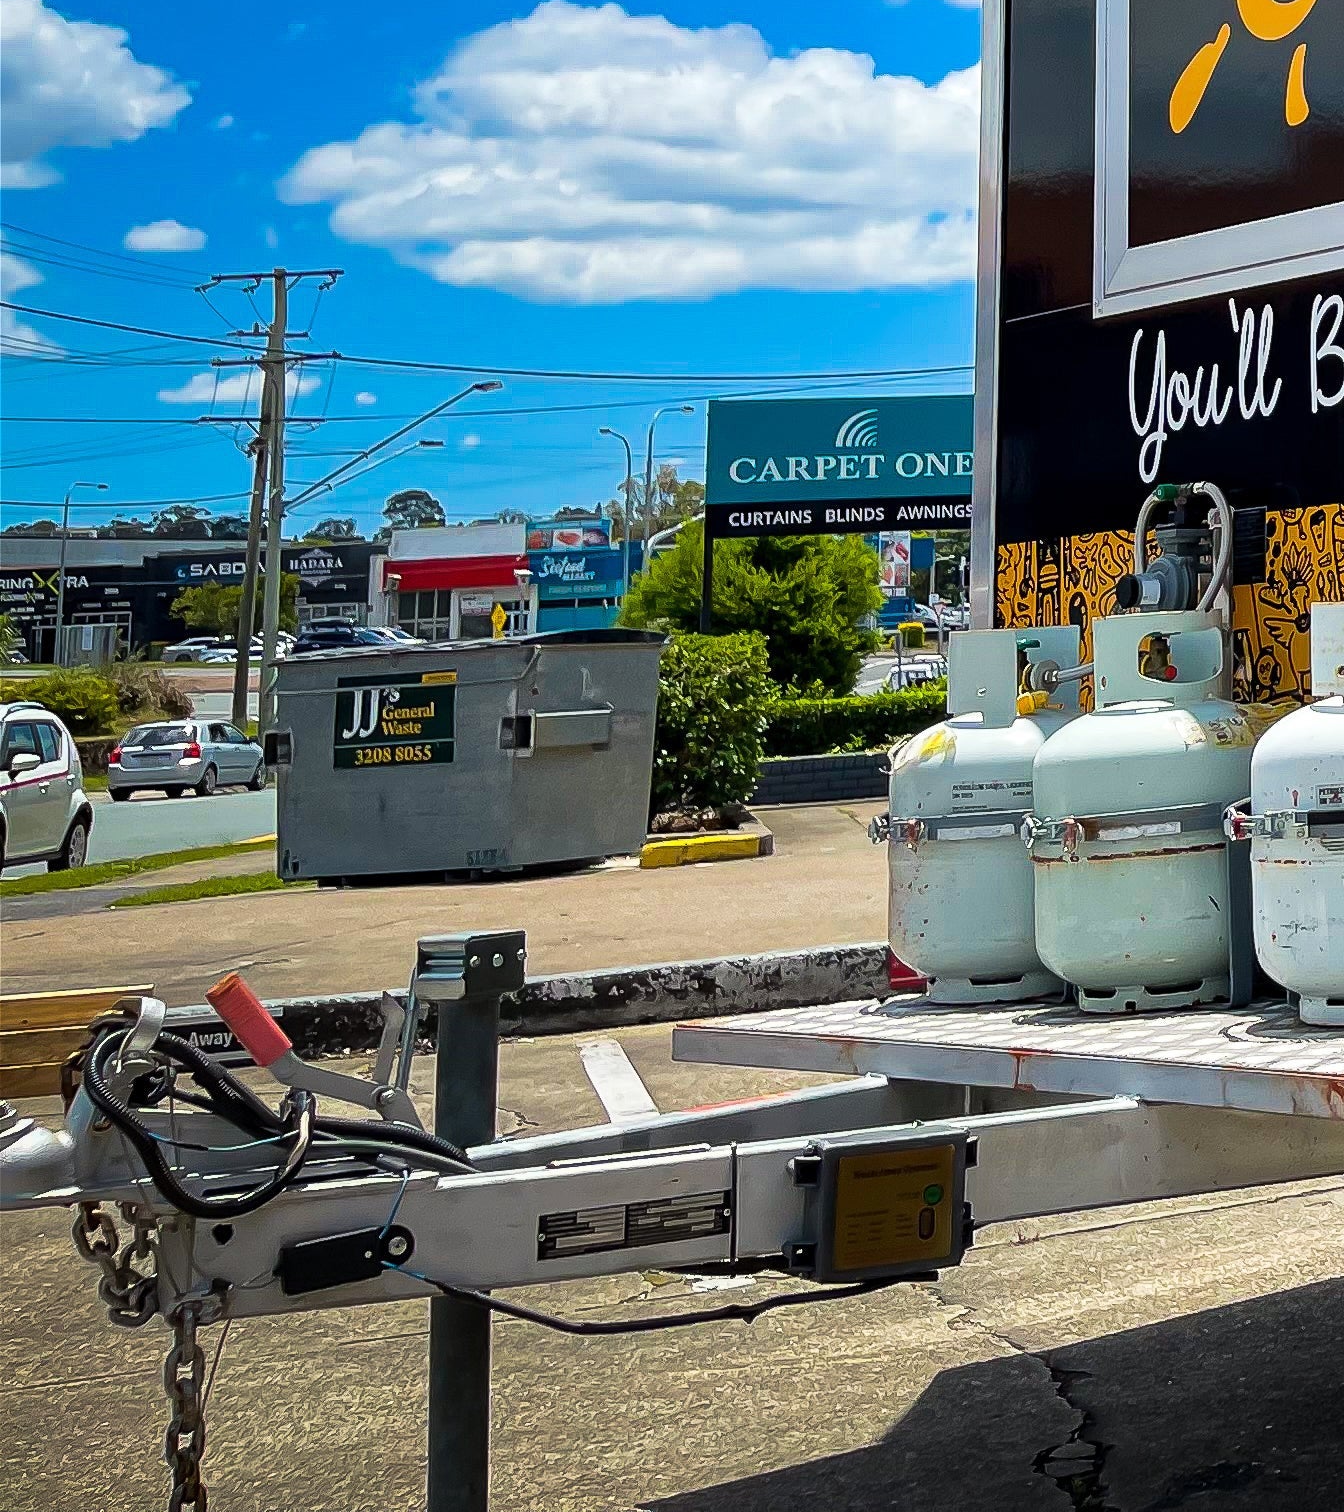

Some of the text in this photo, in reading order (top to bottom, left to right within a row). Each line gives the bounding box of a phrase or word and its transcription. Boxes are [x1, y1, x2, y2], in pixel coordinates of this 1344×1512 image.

[1128, 298, 1282, 483] You'll
[729, 451, 974, 484] CARPET ONE
[728, 504, 974, 527] CURTAINS BLINDS AWNINGS
[289, 556, 344, 571] HADARA
[342, 688, 400, 739] JJ's
[382, 701, 435, 720] General
[381, 721, 422, 735] Waste
[355, 744, 432, 766] 3208 8055
[188, 1031, 233, 1047] Away
